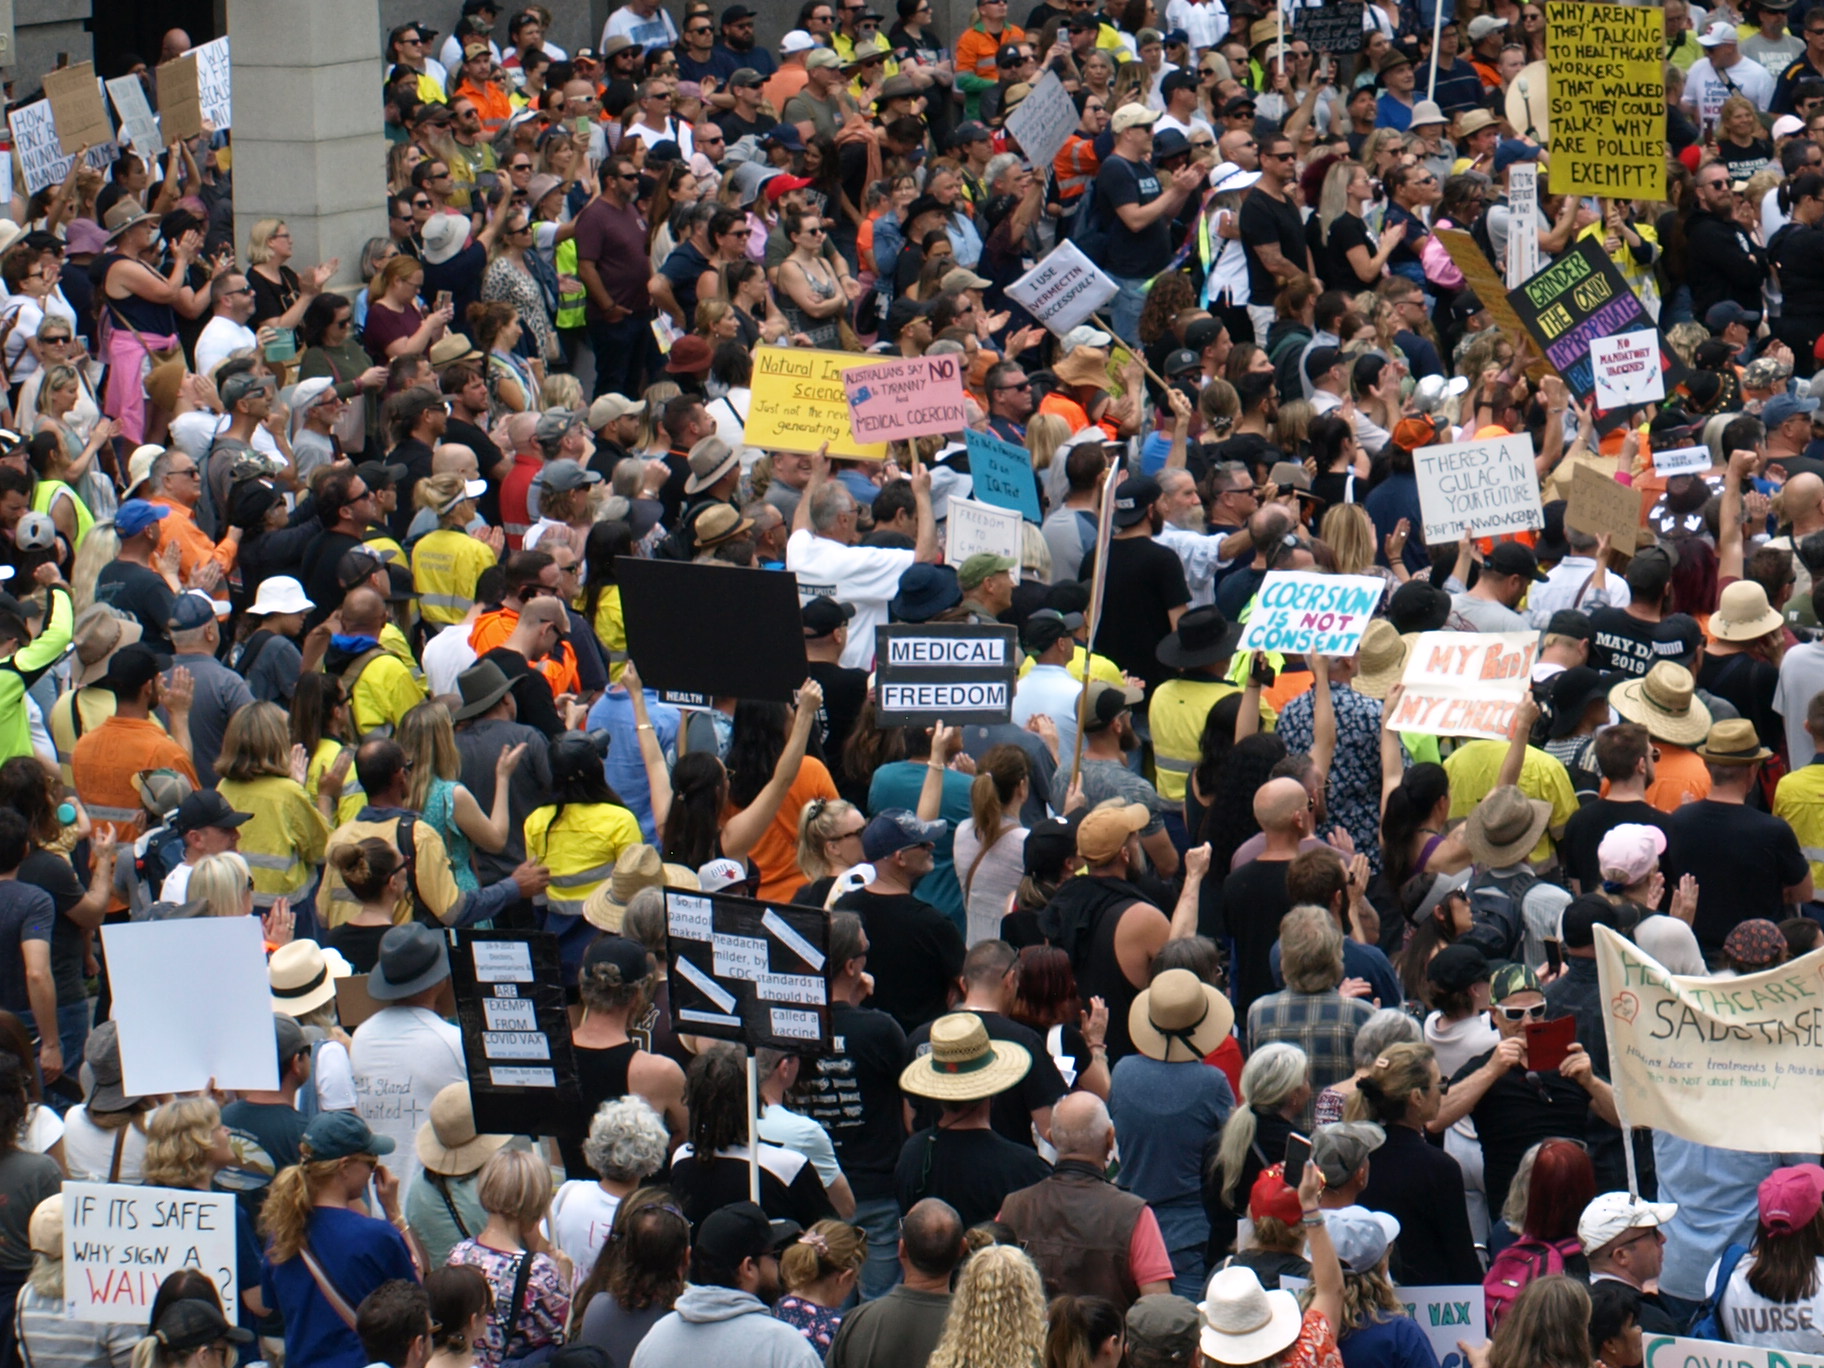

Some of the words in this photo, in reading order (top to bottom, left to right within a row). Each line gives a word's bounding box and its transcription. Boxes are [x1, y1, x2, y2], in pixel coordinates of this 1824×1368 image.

[1550, 4, 1585, 22] WHY
[1591, 7, 1651, 27] AREN'T
[1551, 25, 1585, 41] THEY
[1593, 26, 1662, 43] TALKING
[1550, 45, 1570, 59] TO
[1575, 45, 1664, 62] HEALTHCARE
[1549, 62, 1624, 78] WORKERS
[1557, 80, 1594, 96] THAT
[1602, 83, 1664, 98] WALKED
[1552, 99, 1572, 114] SO
[1580, 100, 1616, 116] THEY
[1622, 102, 1664, 116] COULD
[1550, 116, 1603, 135] TALK?
[1612, 119, 1653, 136] WHY
[1552, 137, 1587, 154] ARE
[1597, 139, 1664, 156] POLLIES
[1571, 162, 1657, 188] EXEMPT?
[1029, 282, 1038, 291] I
[1037, 266, 1057, 285] USE
[1528, 252, 1590, 308] GRINDER
[1539, 306, 1572, 338] THE
[1574, 272, 1612, 311] ONLY
[1551, 294, 1641, 369] APPROPRIATE
[1617, 338, 1630, 350] NO
[760, 355, 813, 377] Natural
[1600, 348, 1650, 365] MANDATORY
[846, 367, 904, 384] AUSTRALIANS
[907, 364, 924, 375] SAY
[929, 360, 954, 380] NO
[793, 384, 845, 400] Science
[880, 379, 926, 395] TYRANNY
[855, 414, 904, 432] MEDICAL
[907, 404, 965, 424] COERCION
[773, 420, 840, 441] generating
[1420, 448, 1489, 474] THERE'S
[1499, 444, 1511, 462] A
[1438, 466, 1500, 493] GULAG
[1508, 463, 1526, 481] IN
[1444, 492, 1482, 514] YOUR
[1483, 483, 1533, 507] FUTURE
[1262, 582, 1377, 615] COERSION
[1268, 611, 1288, 628] IS
[1300, 613, 1354, 631] NOT
[1248, 627, 1358, 652] CONSENT
[1595, 632, 1633, 652] MAY
[892, 642, 1002, 661] MEDICAL
[1426, 645, 1478, 675] MY
[1611, 653, 1645, 675] 2019
[666, 691, 703, 704] HEALTH
[885, 686, 1004, 705] FREEDOM
[1395, 695, 1438, 725] MY
[668, 911, 711, 926] panadol
[712, 934, 767, 951] headache
[729, 967, 752, 978] CDC
[756, 972, 812, 988] standards
[496, 986, 516, 997] ARE
[763, 988, 801, 1001] should
[806, 991, 820, 1003] be
[495, 1019, 528, 1030] FROM
[772, 1010, 807, 1022] called
[484, 1033, 517, 1045] COVID
[773, 1026, 817, 1038] vaccine
[73, 1196, 96, 1228] IF
[108, 1199, 138, 1230] ITS
[151, 1200, 218, 1230] SAFE
[73, 1242, 114, 1263] WHY
[119, 1246, 169, 1264] SIGN
[183, 1246, 202, 1268] A
[1428, 1302, 1471, 1326] VAX
[1732, 1307, 1814, 1333] NURSE
